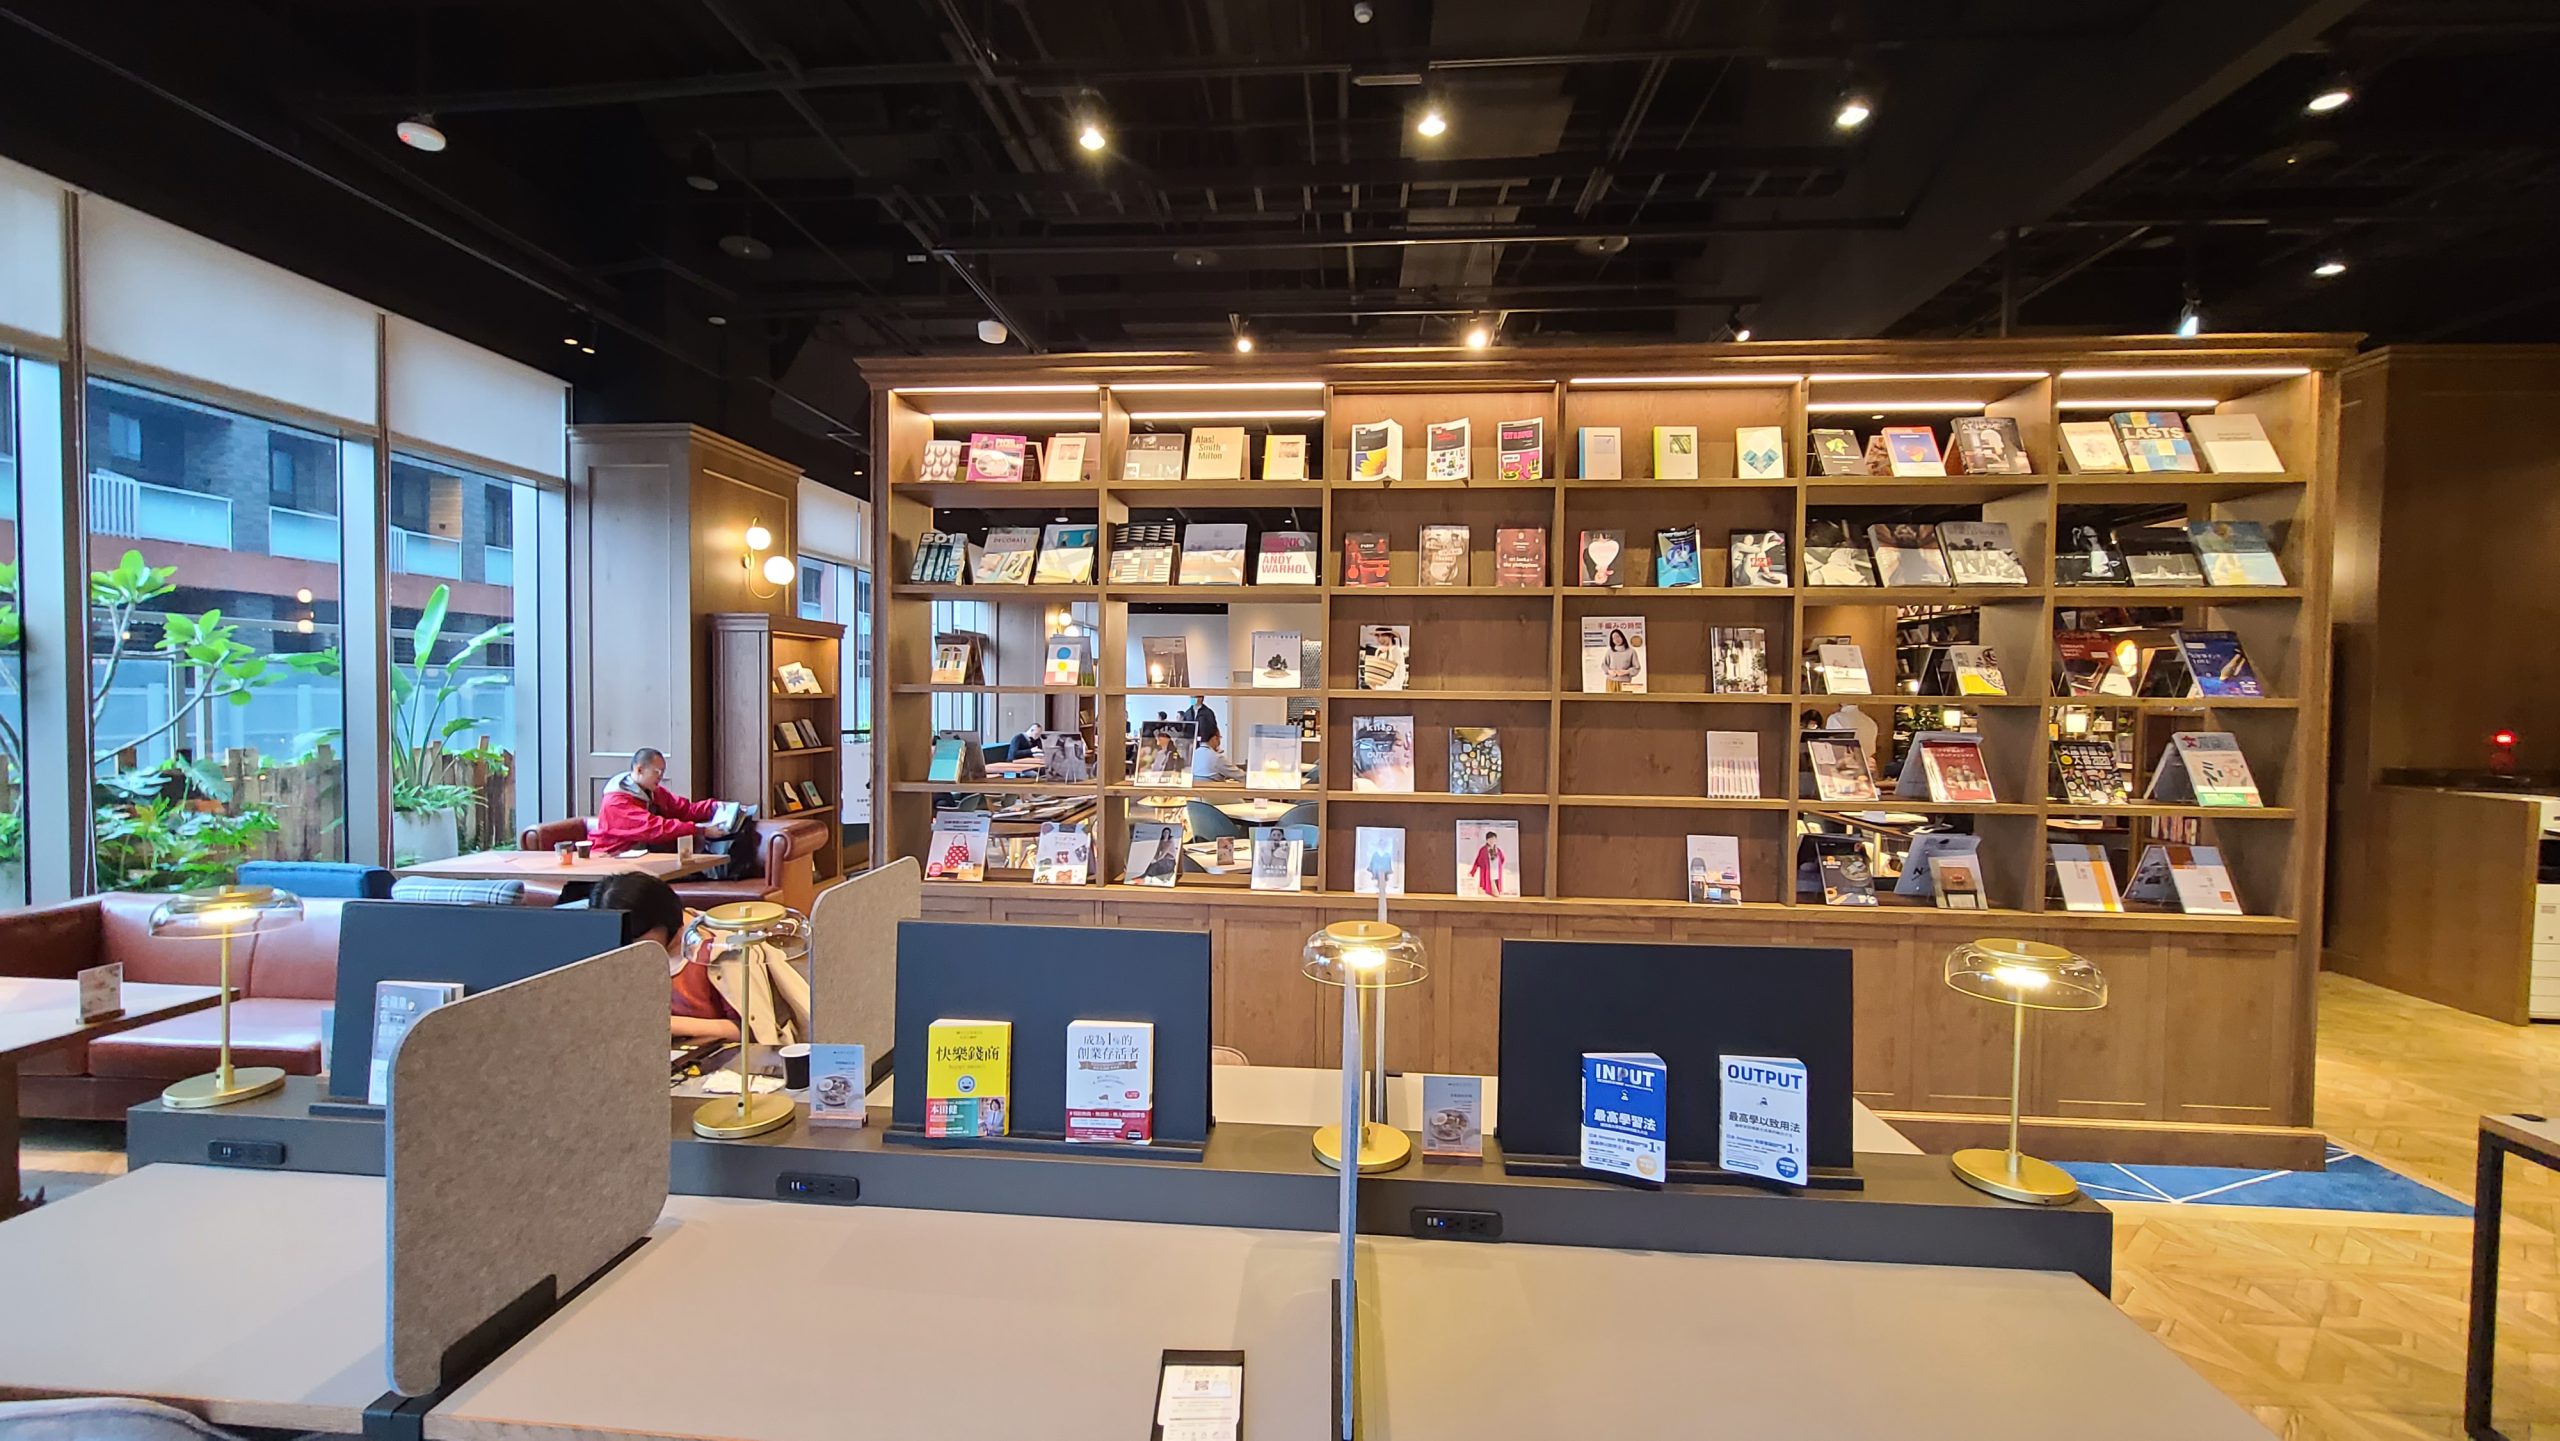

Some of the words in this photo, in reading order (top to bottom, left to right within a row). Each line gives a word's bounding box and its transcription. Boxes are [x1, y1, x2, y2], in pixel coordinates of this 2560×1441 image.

[1195, 435, 1214, 444] Alas!
[2122, 427, 2185, 440] LASTS
[921, 533, 955, 544] 501
[1262, 556, 1292, 564] ANDY
[1261, 565, 1308, 575] WARHOL
[936, 1046, 1000, 1061] 快樂錢商
[1595, 1063, 1655, 1088] INPUT
[1728, 1064, 1803, 1090] OUTPUT
[1594, 1108, 1657, 1132] 最高學習法
[1729, 1111, 1801, 1133] 最高學以致用法
